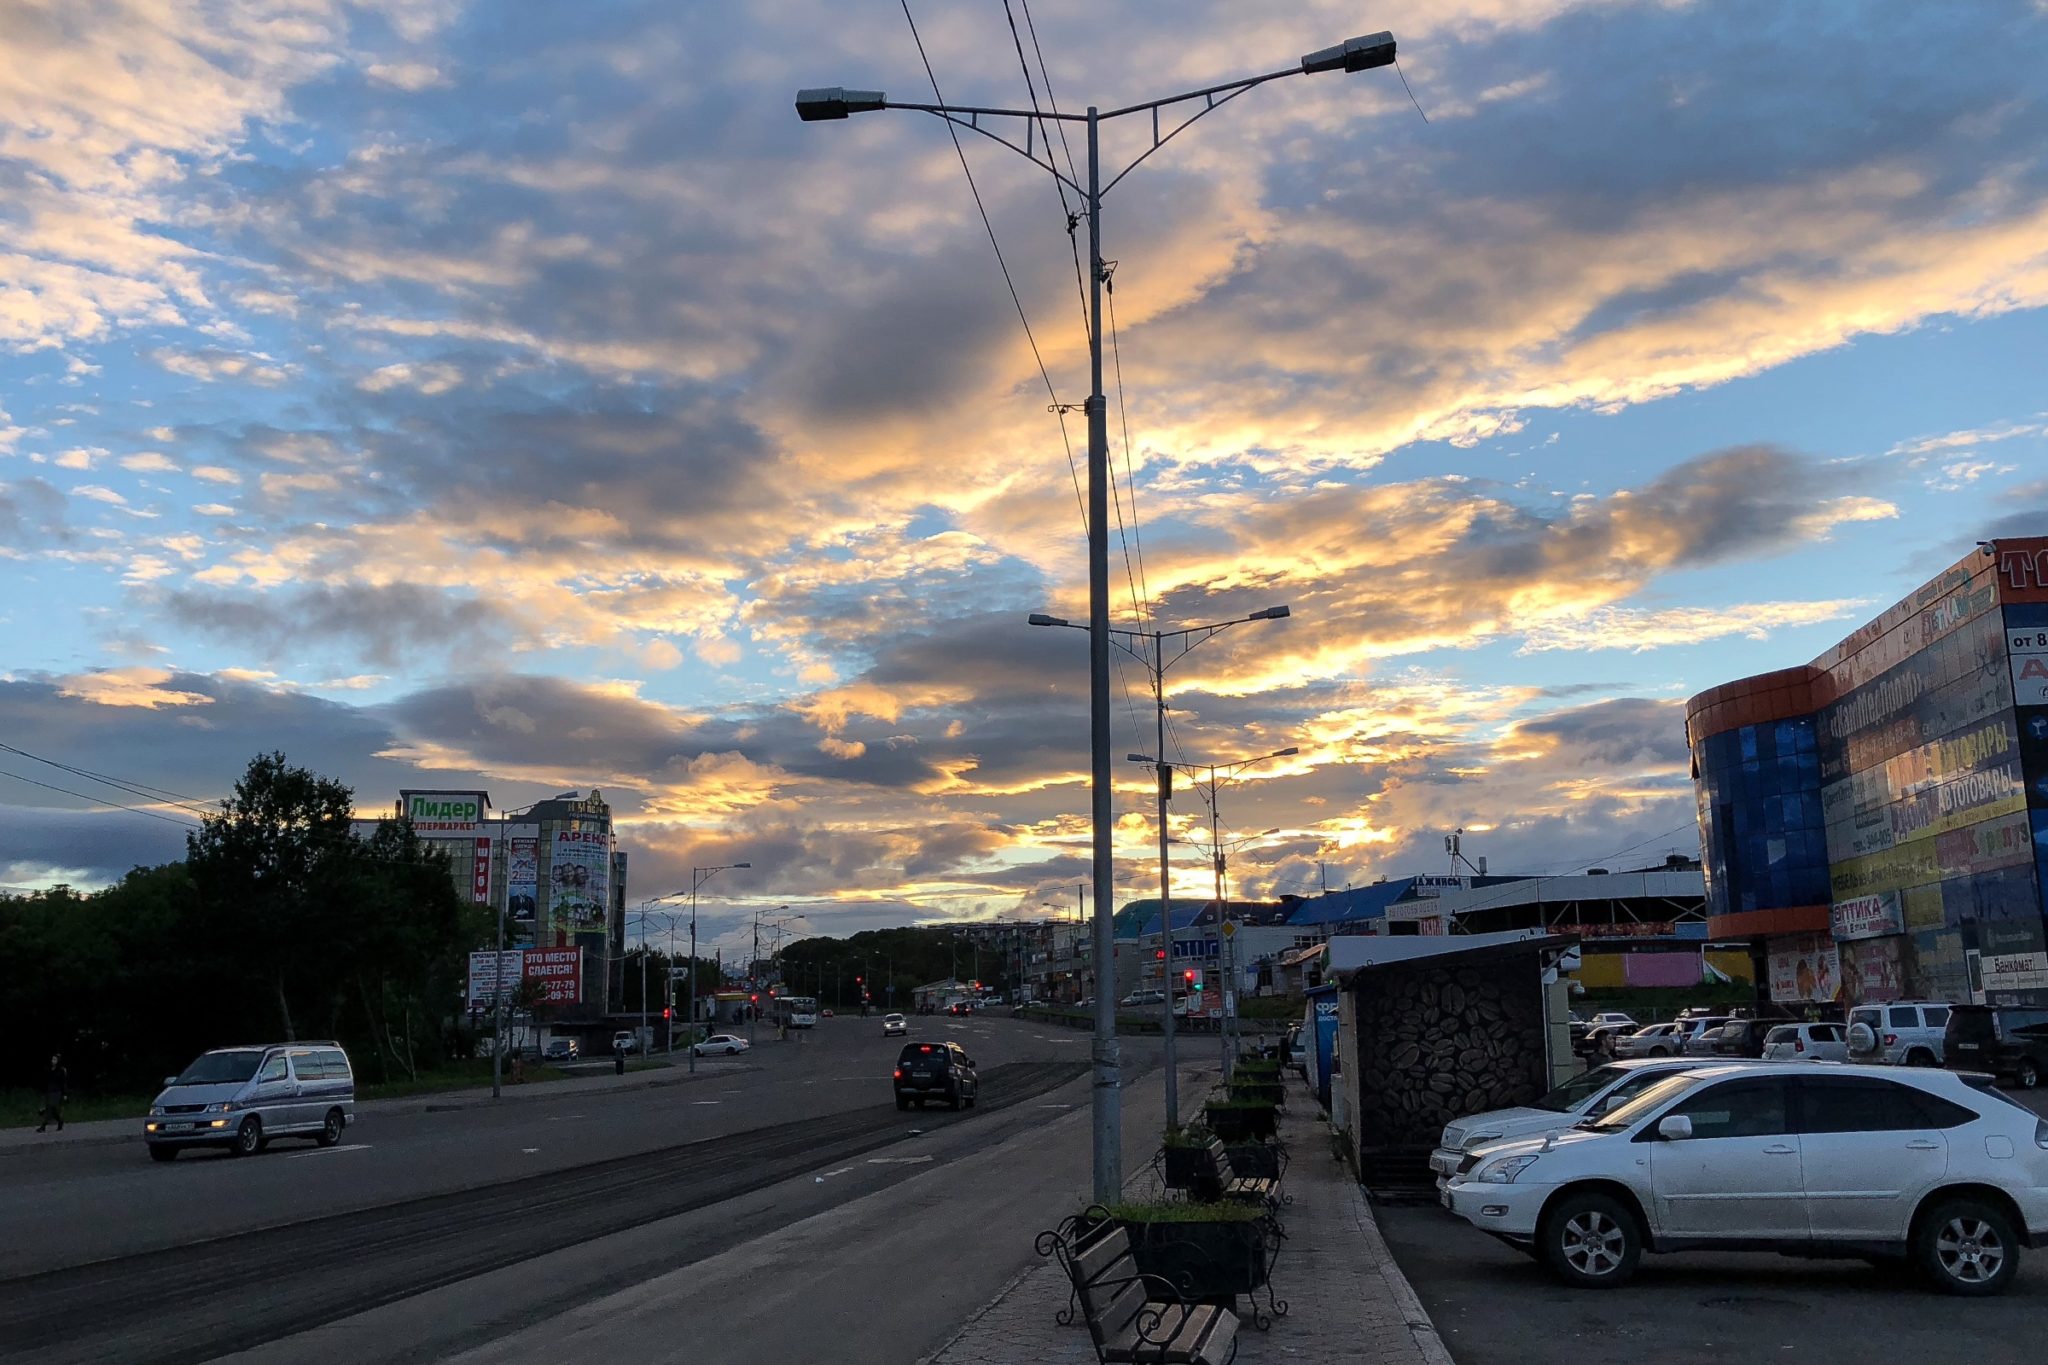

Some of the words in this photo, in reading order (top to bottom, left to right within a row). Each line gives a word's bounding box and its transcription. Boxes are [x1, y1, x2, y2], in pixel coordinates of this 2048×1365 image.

[1938, 763, 2013, 815] АВТОТОВАРЫ
[411, 797, 477, 821] Лидер
[412, 821, 476, 831] УПЕРМАРКЕТ
[1417, 877, 1461, 887] ДЖИНСЫ
[1834, 898, 1881, 923] ОПТИКА
[525, 953, 543, 963] ЭТО
[545, 952, 577, 963] МЕСТО
[528, 964, 573, 976] СДАЕТСЯ!
[1994, 957, 2033, 973] Банкомат
